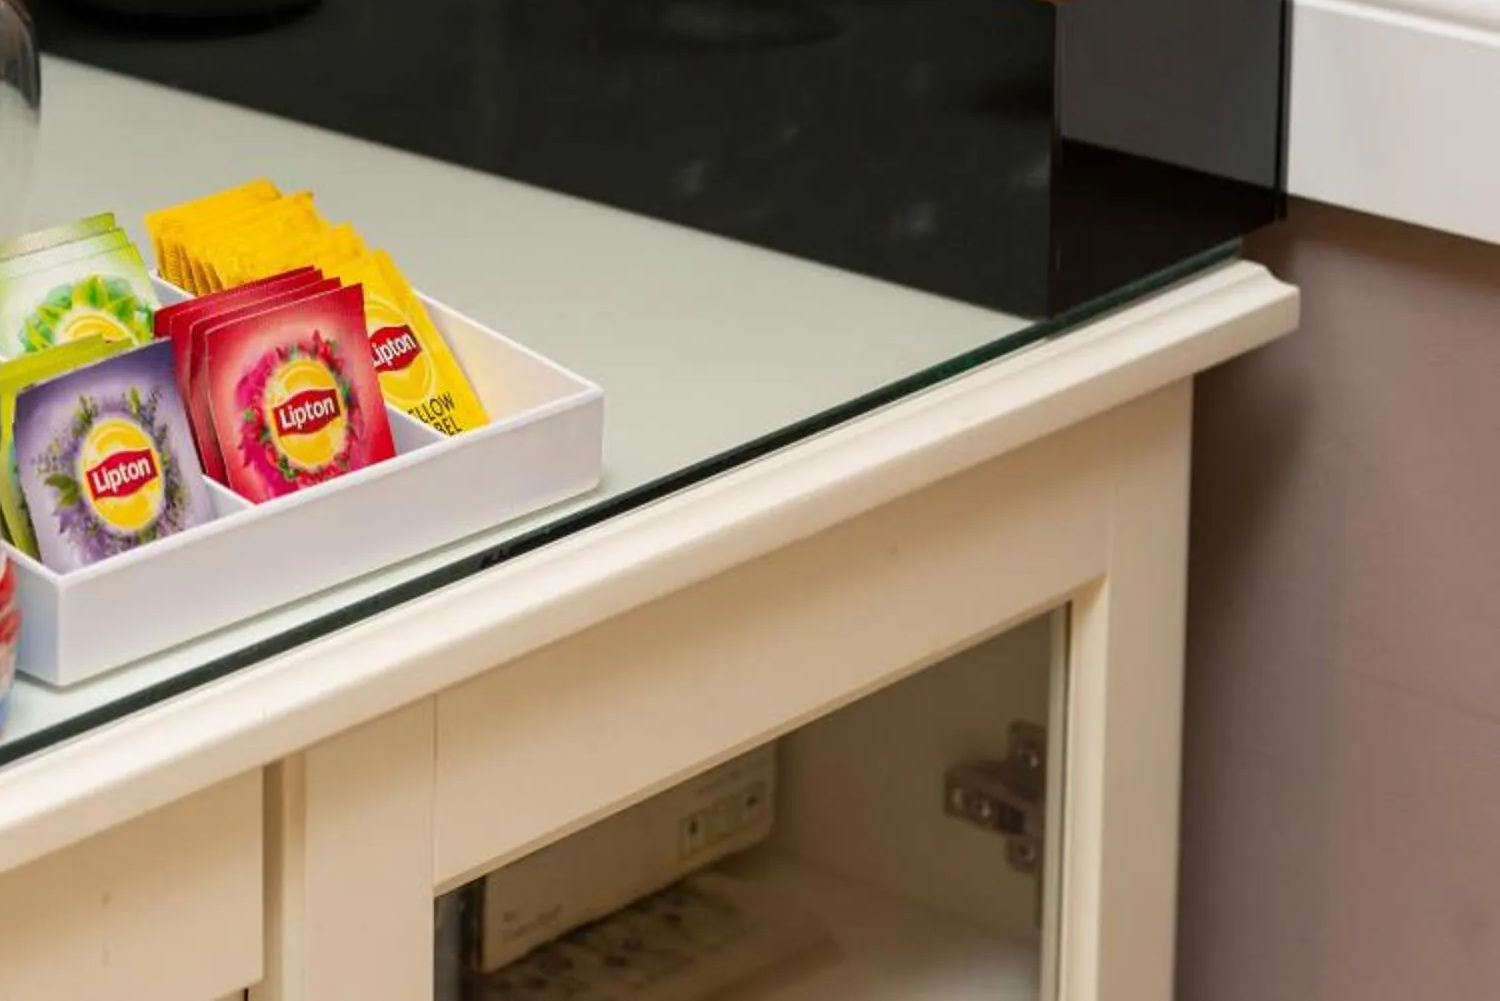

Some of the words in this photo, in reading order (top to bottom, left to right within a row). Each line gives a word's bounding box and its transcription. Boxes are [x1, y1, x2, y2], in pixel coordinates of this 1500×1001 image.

[279, 396, 336, 431] Lipton
[407, 391, 455, 424] LLOW
[433, 416, 463, 437] BEL
[92, 457, 152, 494] Lipton
